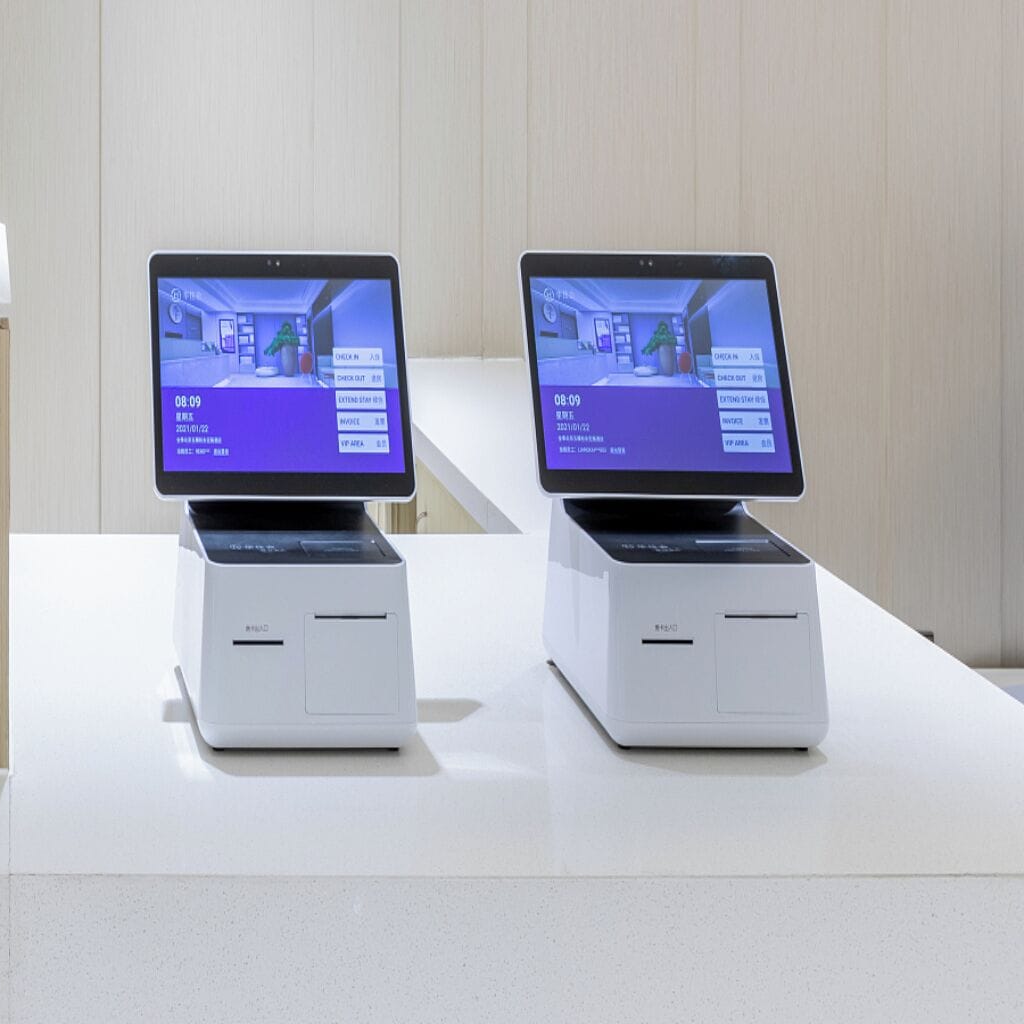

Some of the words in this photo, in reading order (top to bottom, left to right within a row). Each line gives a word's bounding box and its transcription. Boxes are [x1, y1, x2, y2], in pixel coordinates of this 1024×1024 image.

[175, 395, 201, 408] 08:09
[554, 394, 581, 406] 08:09
[176, 424, 208, 433] 2021/01/22
[557, 423, 590, 431] 2021/01/22
